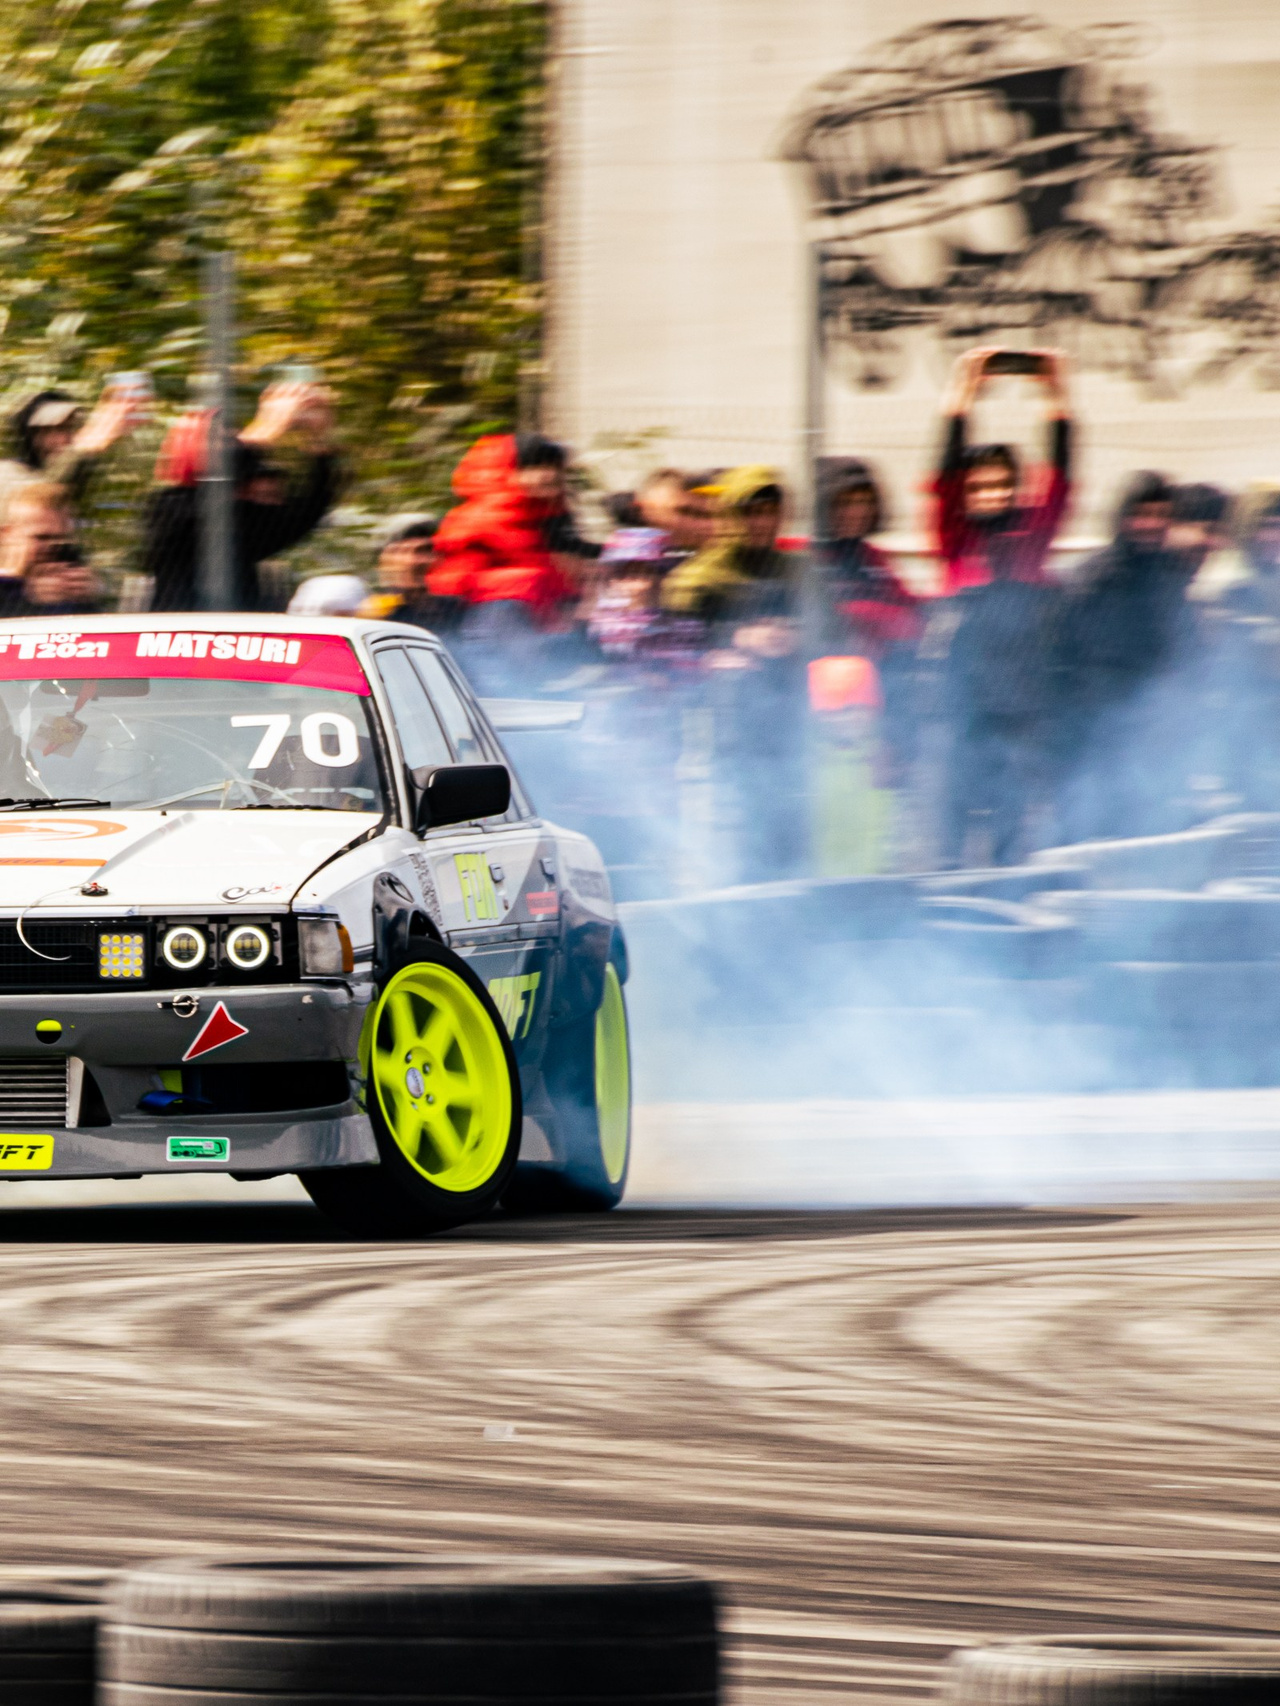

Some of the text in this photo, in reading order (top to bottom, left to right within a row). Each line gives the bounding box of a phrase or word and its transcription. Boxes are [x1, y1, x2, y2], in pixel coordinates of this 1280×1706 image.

[36, 641, 110, 659] 2021
[136, 633, 302, 665] MATSURI
[230, 712, 360, 770] 70
